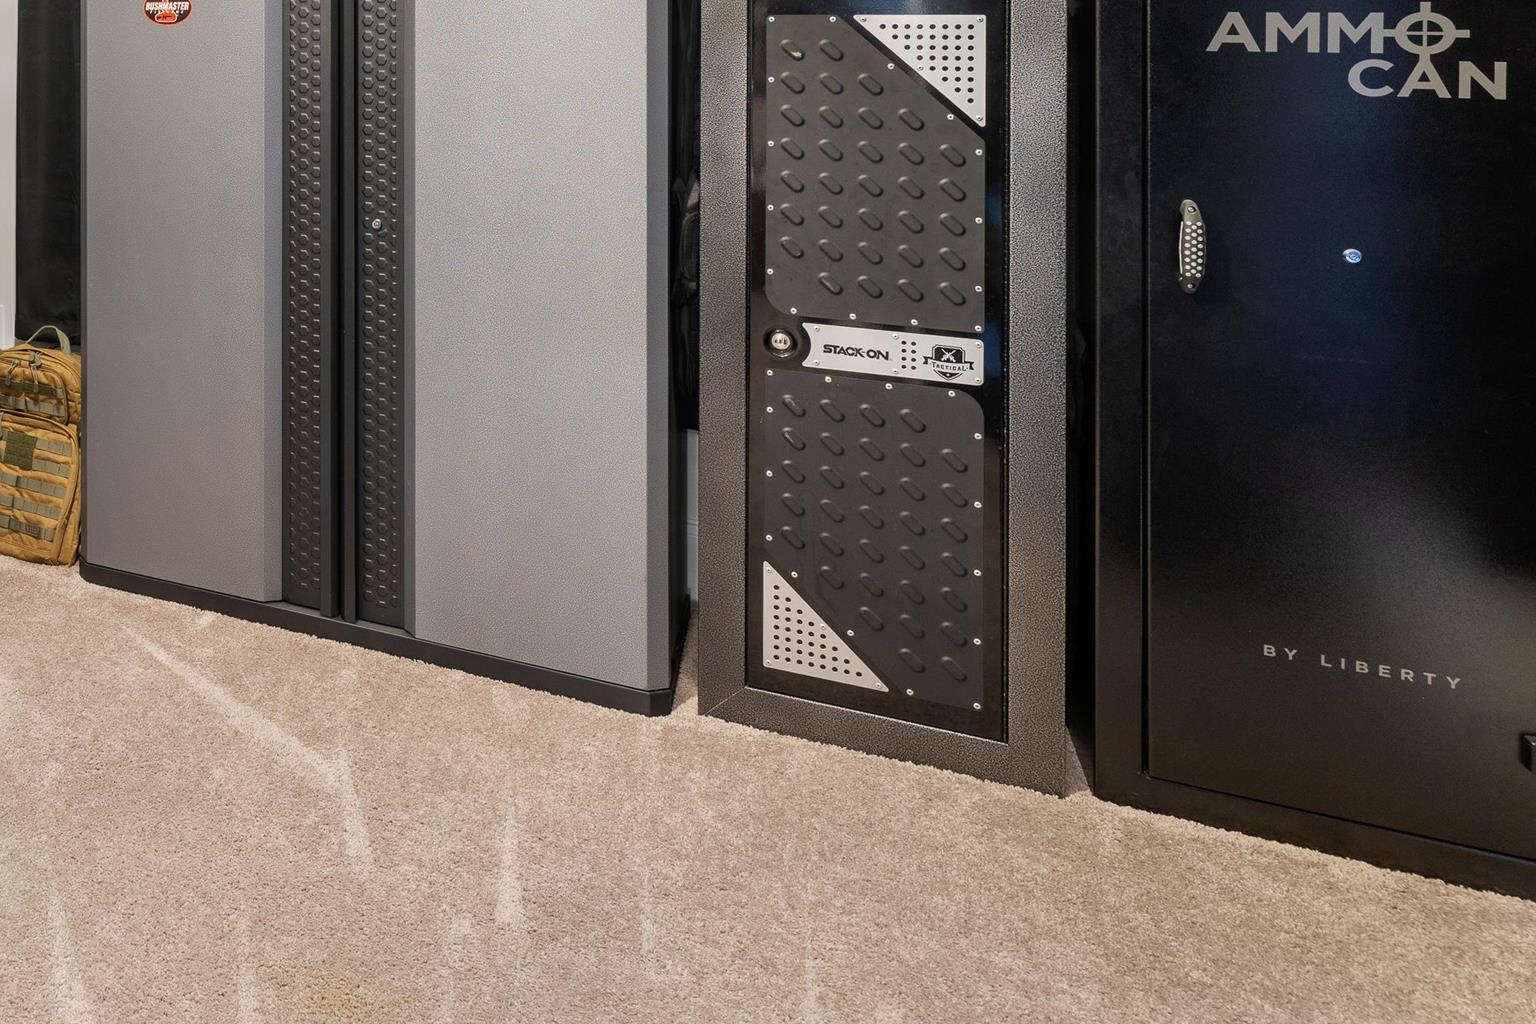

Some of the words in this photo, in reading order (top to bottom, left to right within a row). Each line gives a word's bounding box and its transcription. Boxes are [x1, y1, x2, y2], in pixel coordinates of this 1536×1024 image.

[145, 1, 190, 11] BUSHMASTER
[1206, 5, 1467, 55] AMMO
[1348, 58, 1508, 100] CAN
[823, 343, 890, 361] STACK-ON
[931, 361, 967, 372] TACTICAL
[1263, 643, 1298, 661] BY
[1320, 653, 1462, 690] LIBERTY
